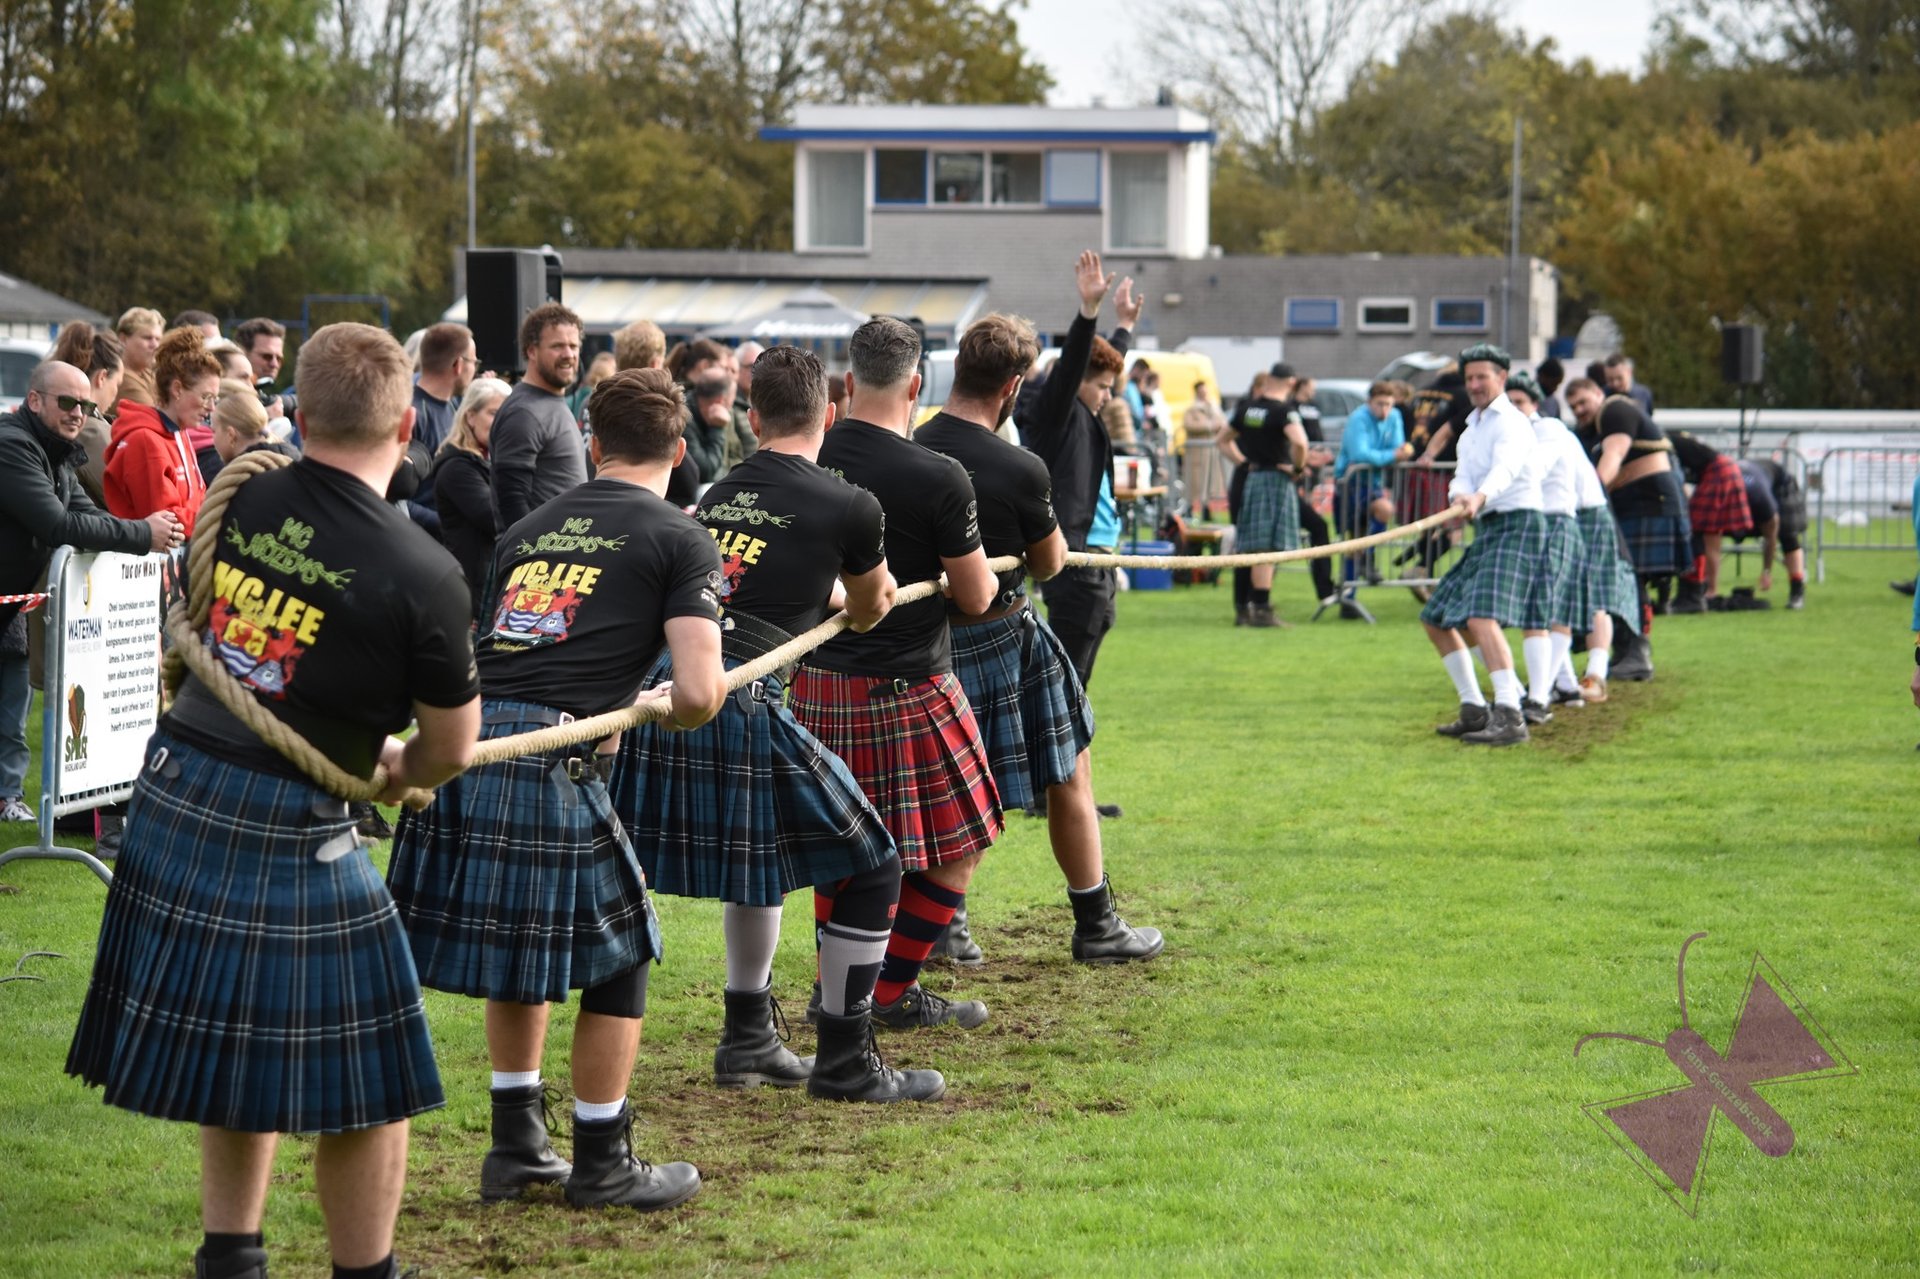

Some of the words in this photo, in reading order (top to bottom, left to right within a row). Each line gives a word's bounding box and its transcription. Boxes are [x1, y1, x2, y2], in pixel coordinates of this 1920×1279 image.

[278, 516, 315, 550] MC
[561, 517, 593, 534] MC
[68, 616, 102, 641] WATERMAN
